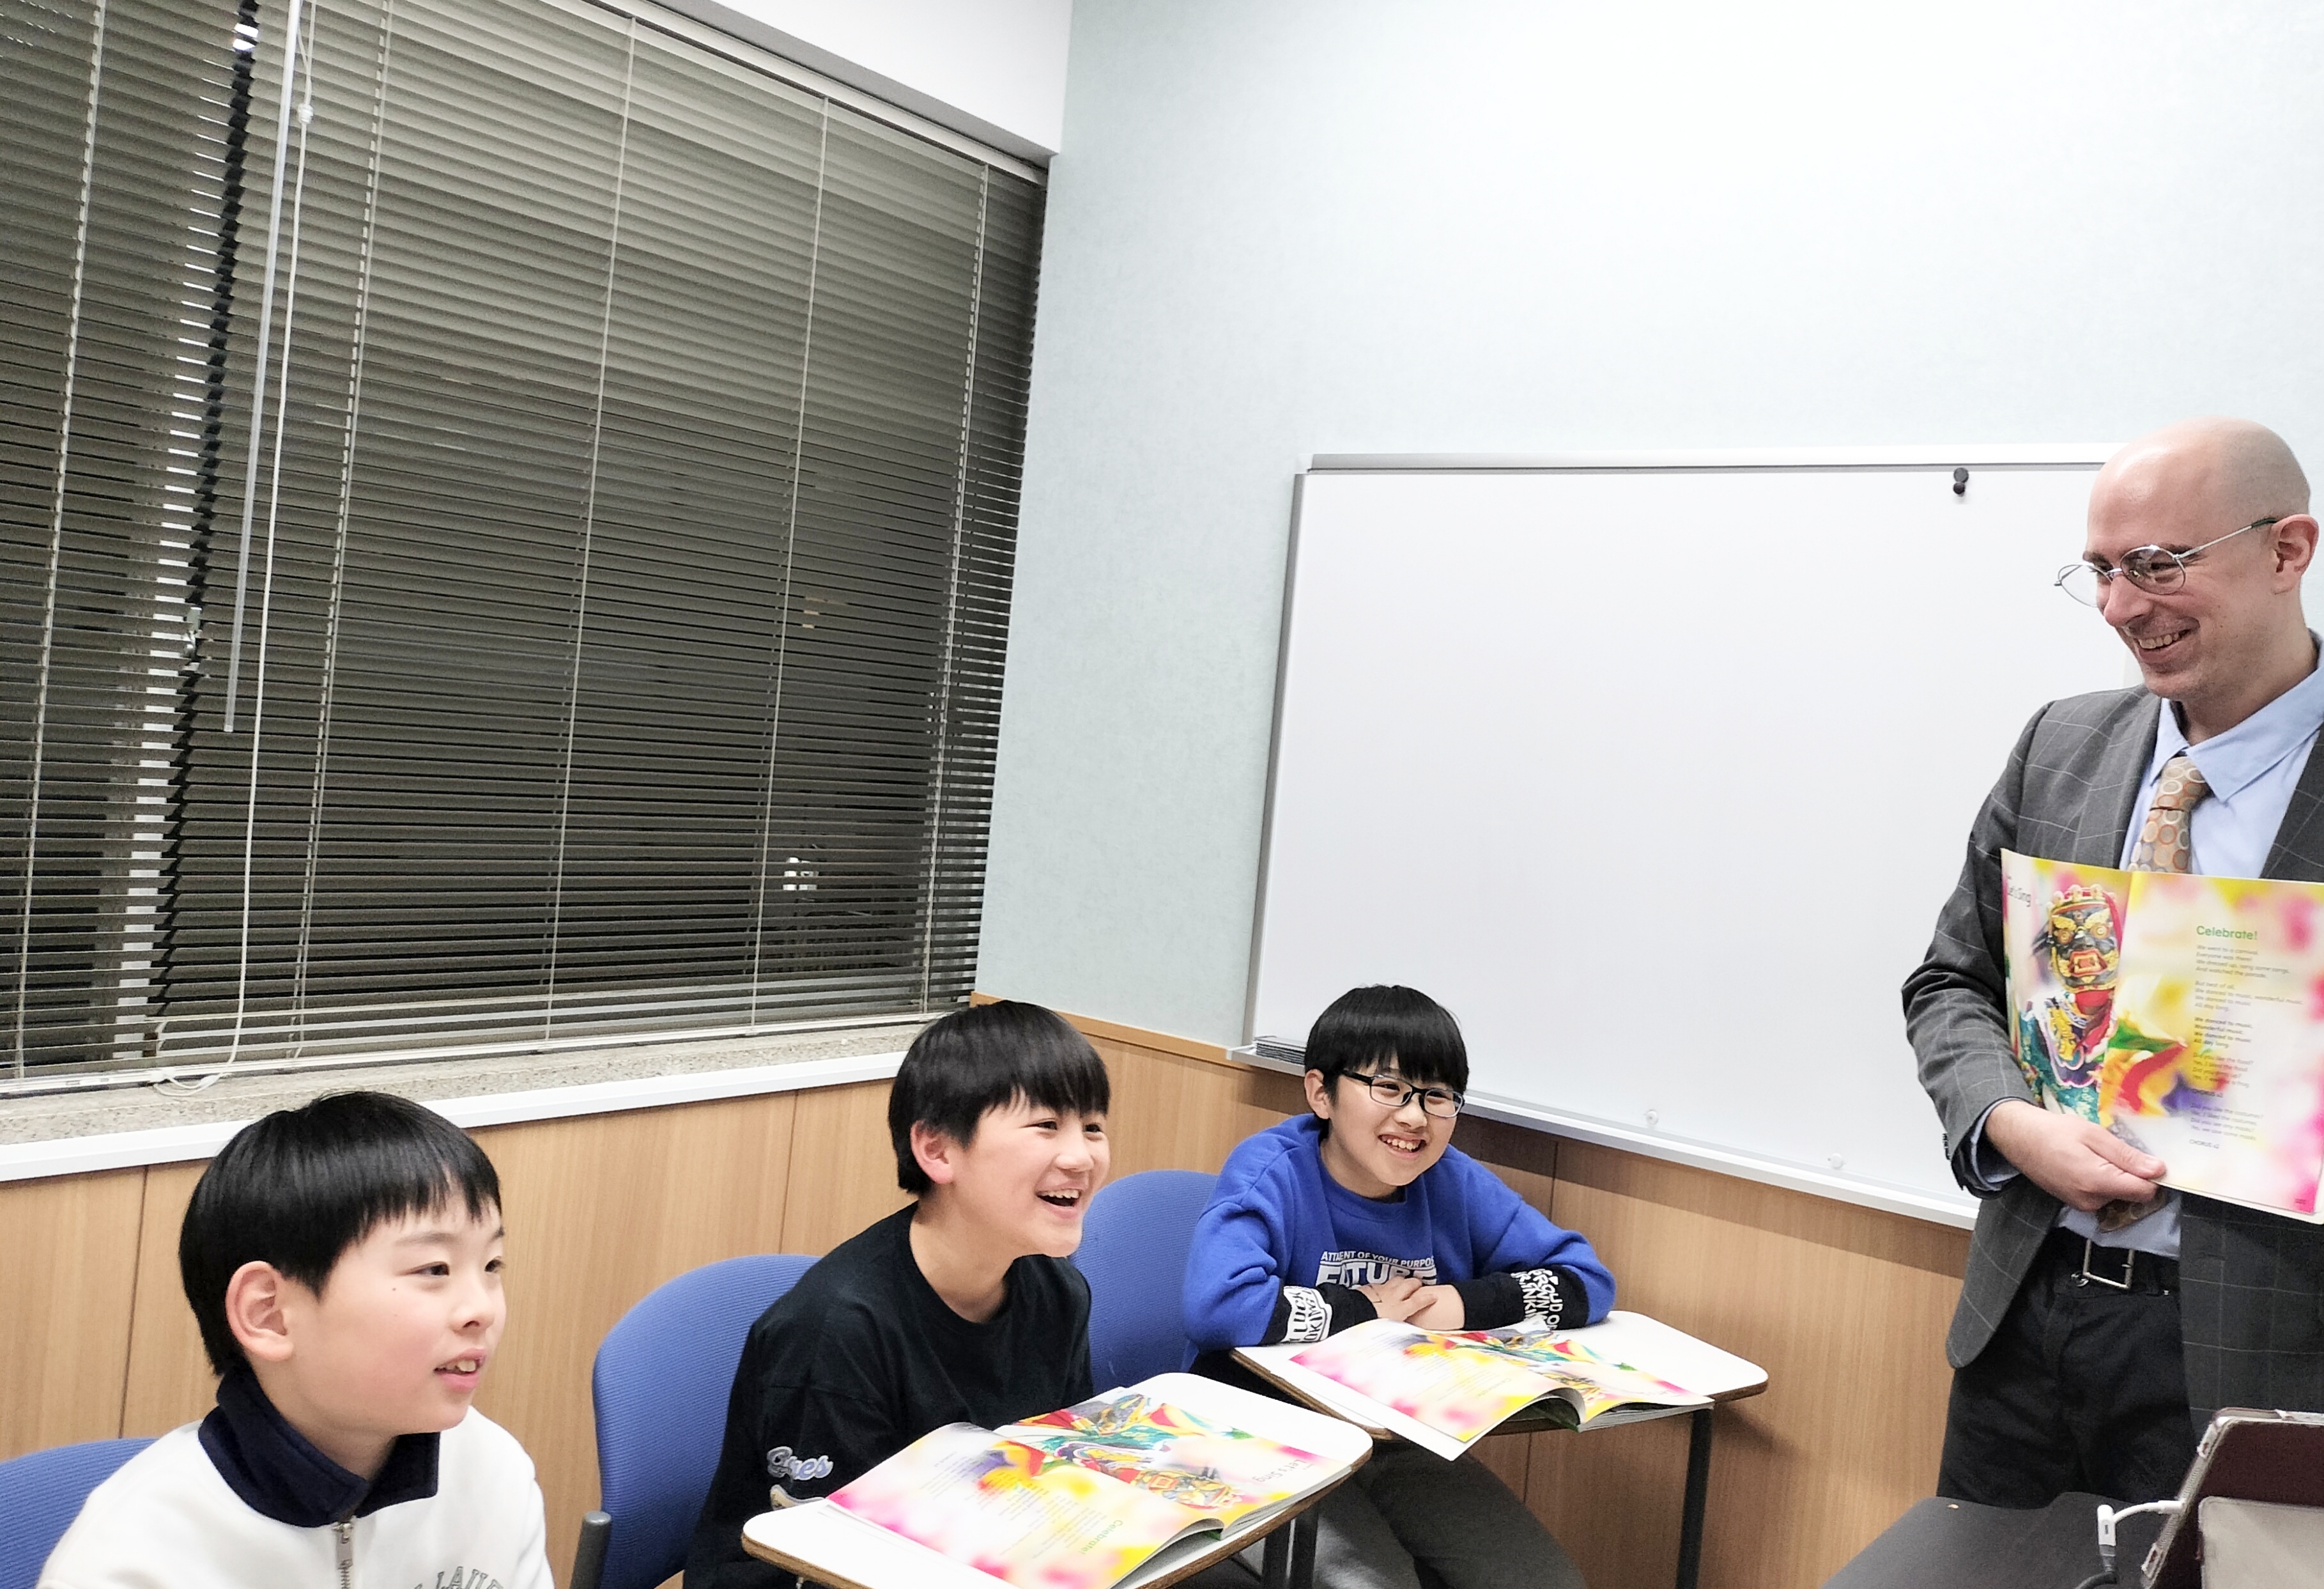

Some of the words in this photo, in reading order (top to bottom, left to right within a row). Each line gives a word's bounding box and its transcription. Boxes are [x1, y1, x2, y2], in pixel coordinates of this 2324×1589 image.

[2196, 926, 2258, 940] Celebrate!
[1371, 1254, 1399, 1264] YOUR
[1401, 1255, 1435, 1267] PURPOS
[1252, 1471, 1283, 1482] Sing
[1079, 1519, 1123, 1555] Celebrate!
